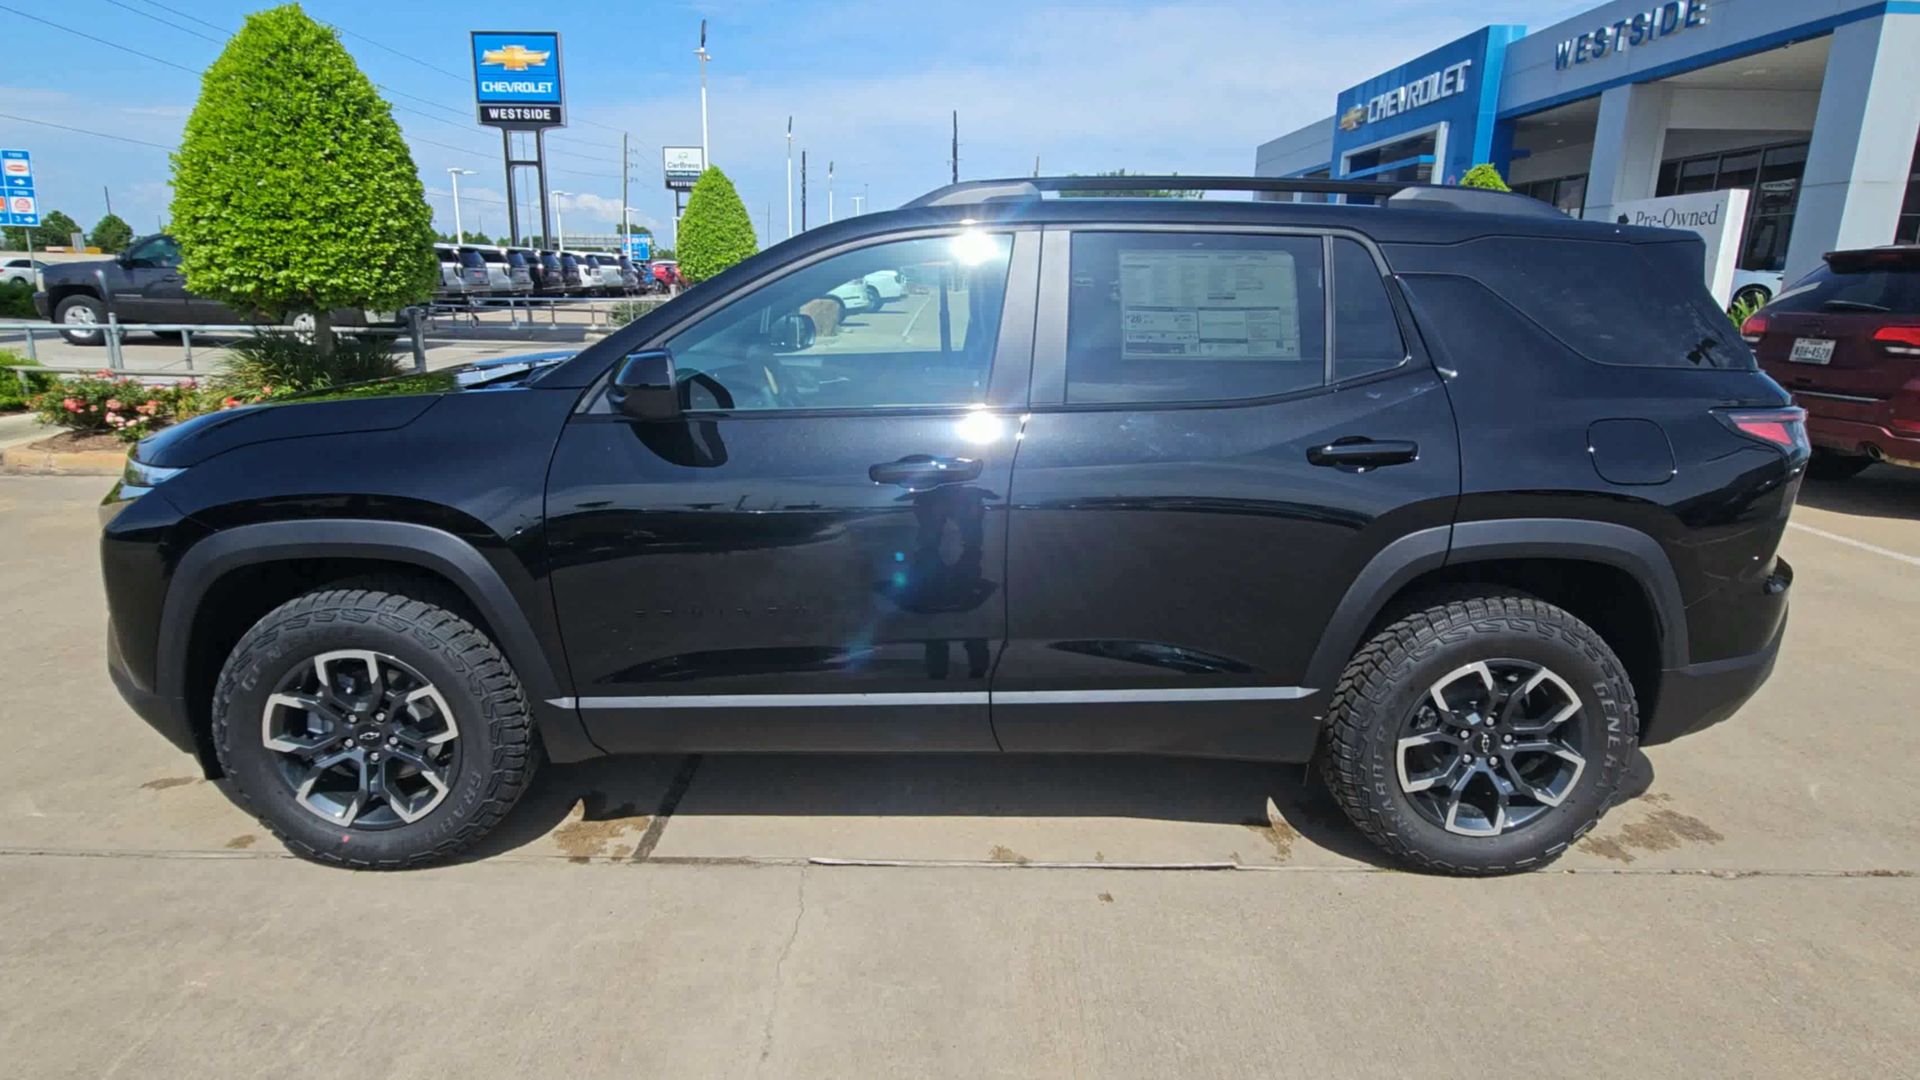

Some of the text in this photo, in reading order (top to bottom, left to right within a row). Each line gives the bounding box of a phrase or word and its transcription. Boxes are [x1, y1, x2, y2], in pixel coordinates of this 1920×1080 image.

[1554, 0, 1706, 71] WESTSIDE
[481, 81, 553, 93] CHEVROLET
[1367, 59, 1472, 124] CHEVROLET
[488, 107, 551, 120] WESTSIDE
[1635, 203, 1720, 229] Pre-Owned
